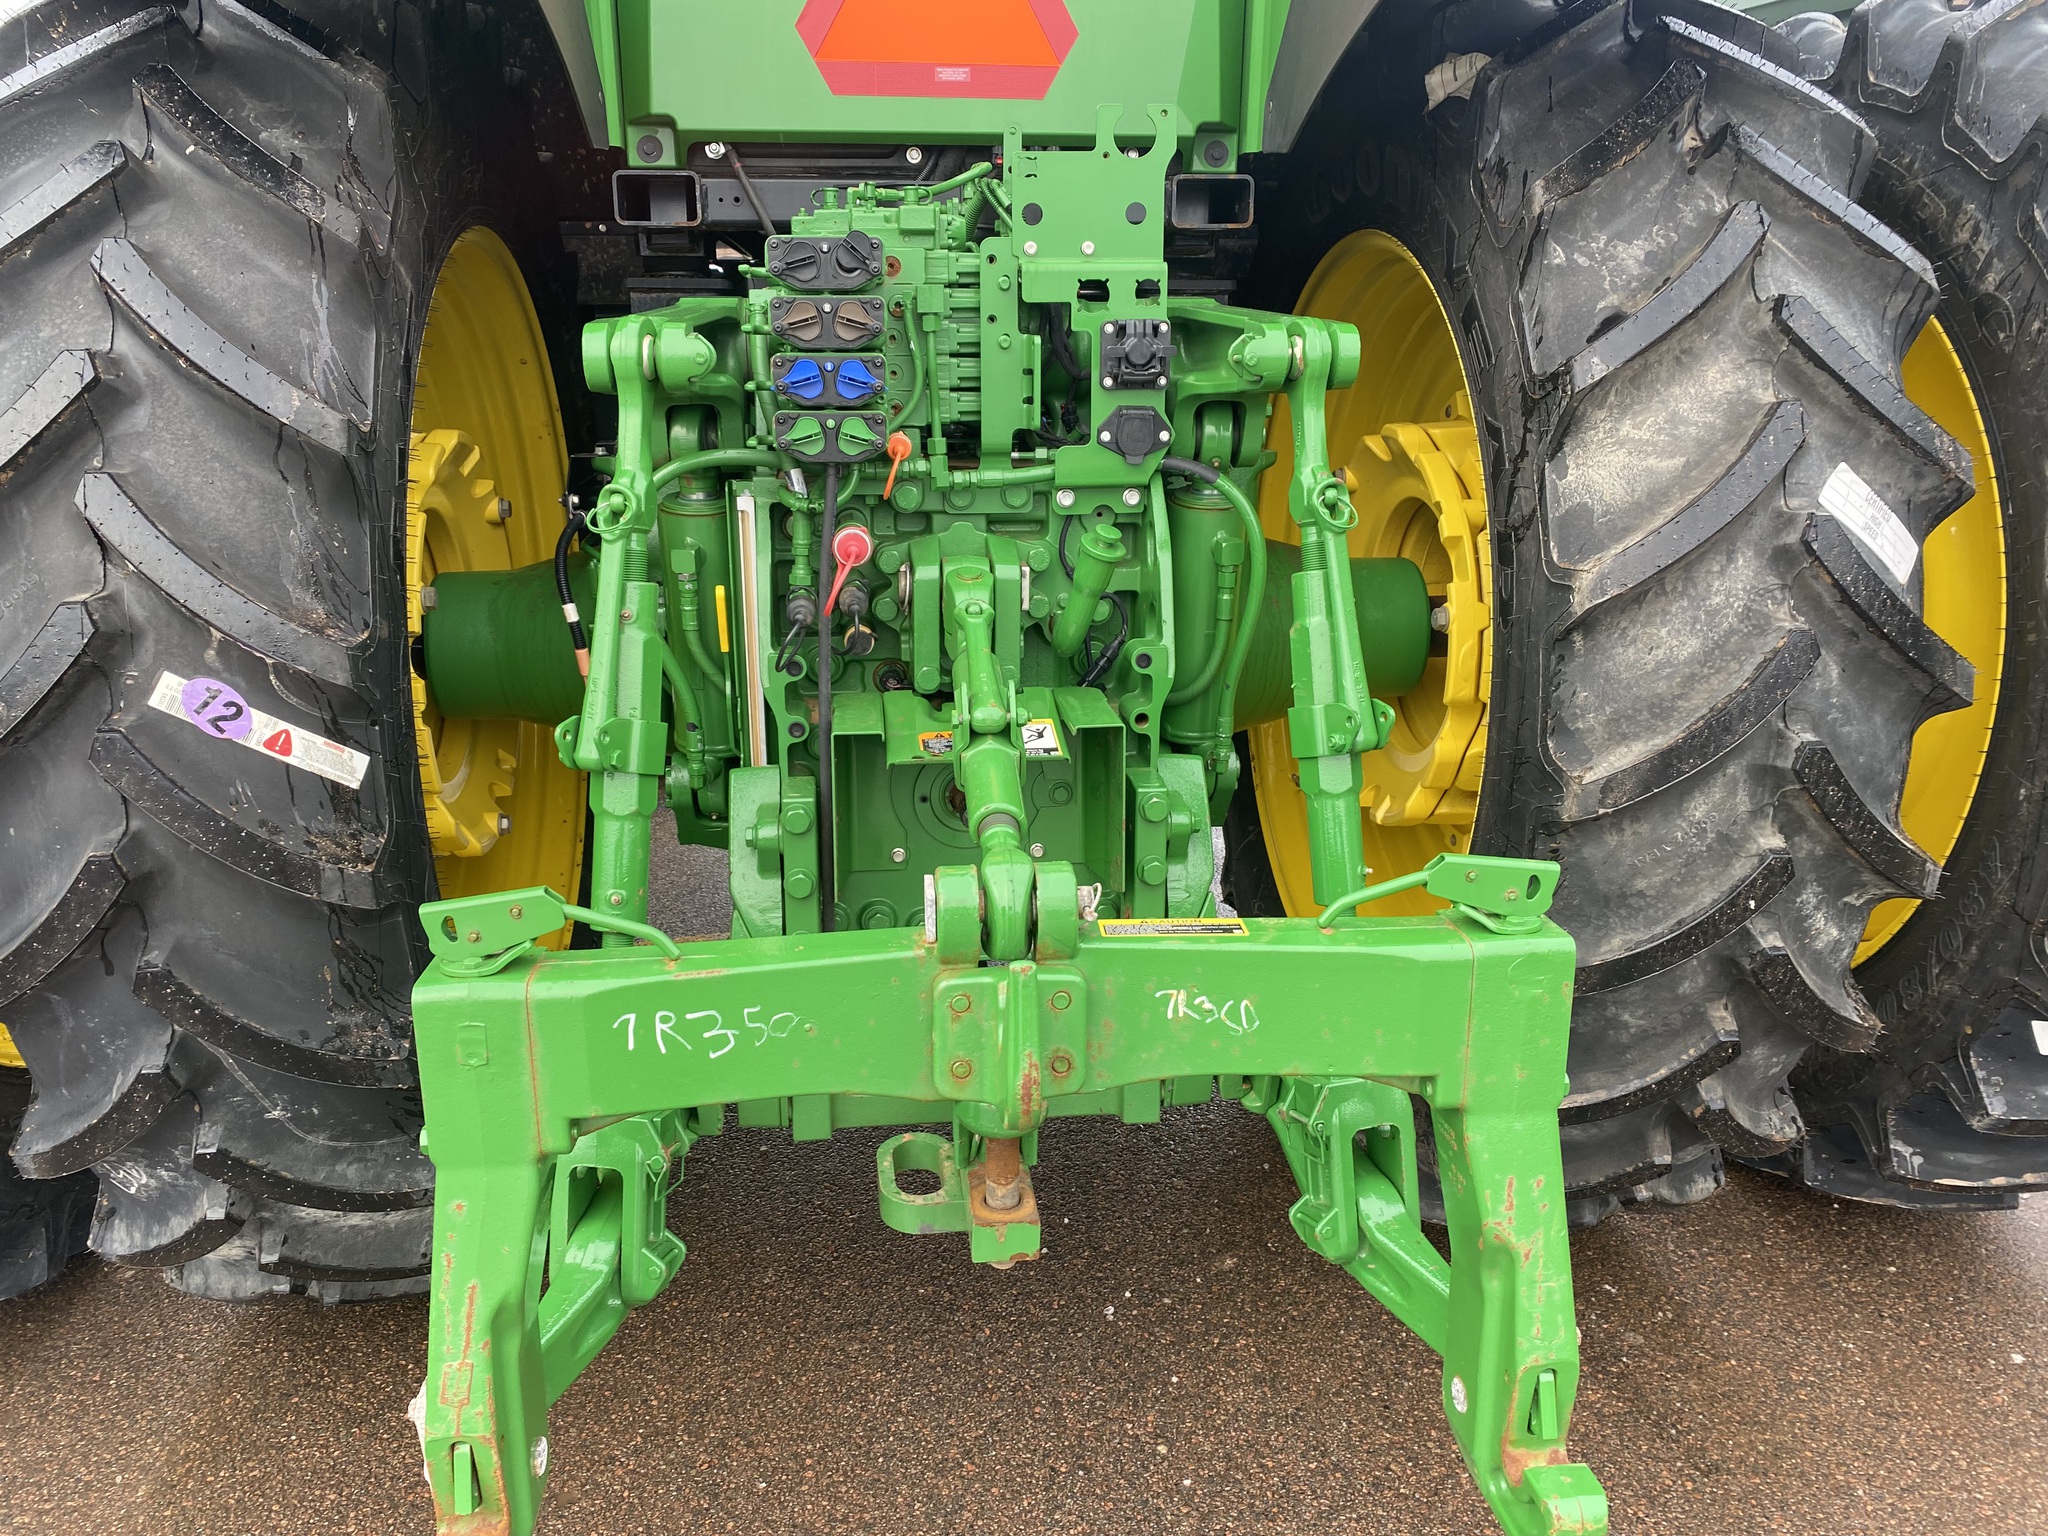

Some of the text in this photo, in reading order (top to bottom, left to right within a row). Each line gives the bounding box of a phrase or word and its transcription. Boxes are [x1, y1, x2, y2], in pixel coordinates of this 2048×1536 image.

[1863, 522, 1879, 540] SPEED
[193, 686, 244, 735] 12
[323, 740, 345, 753] WARNING
